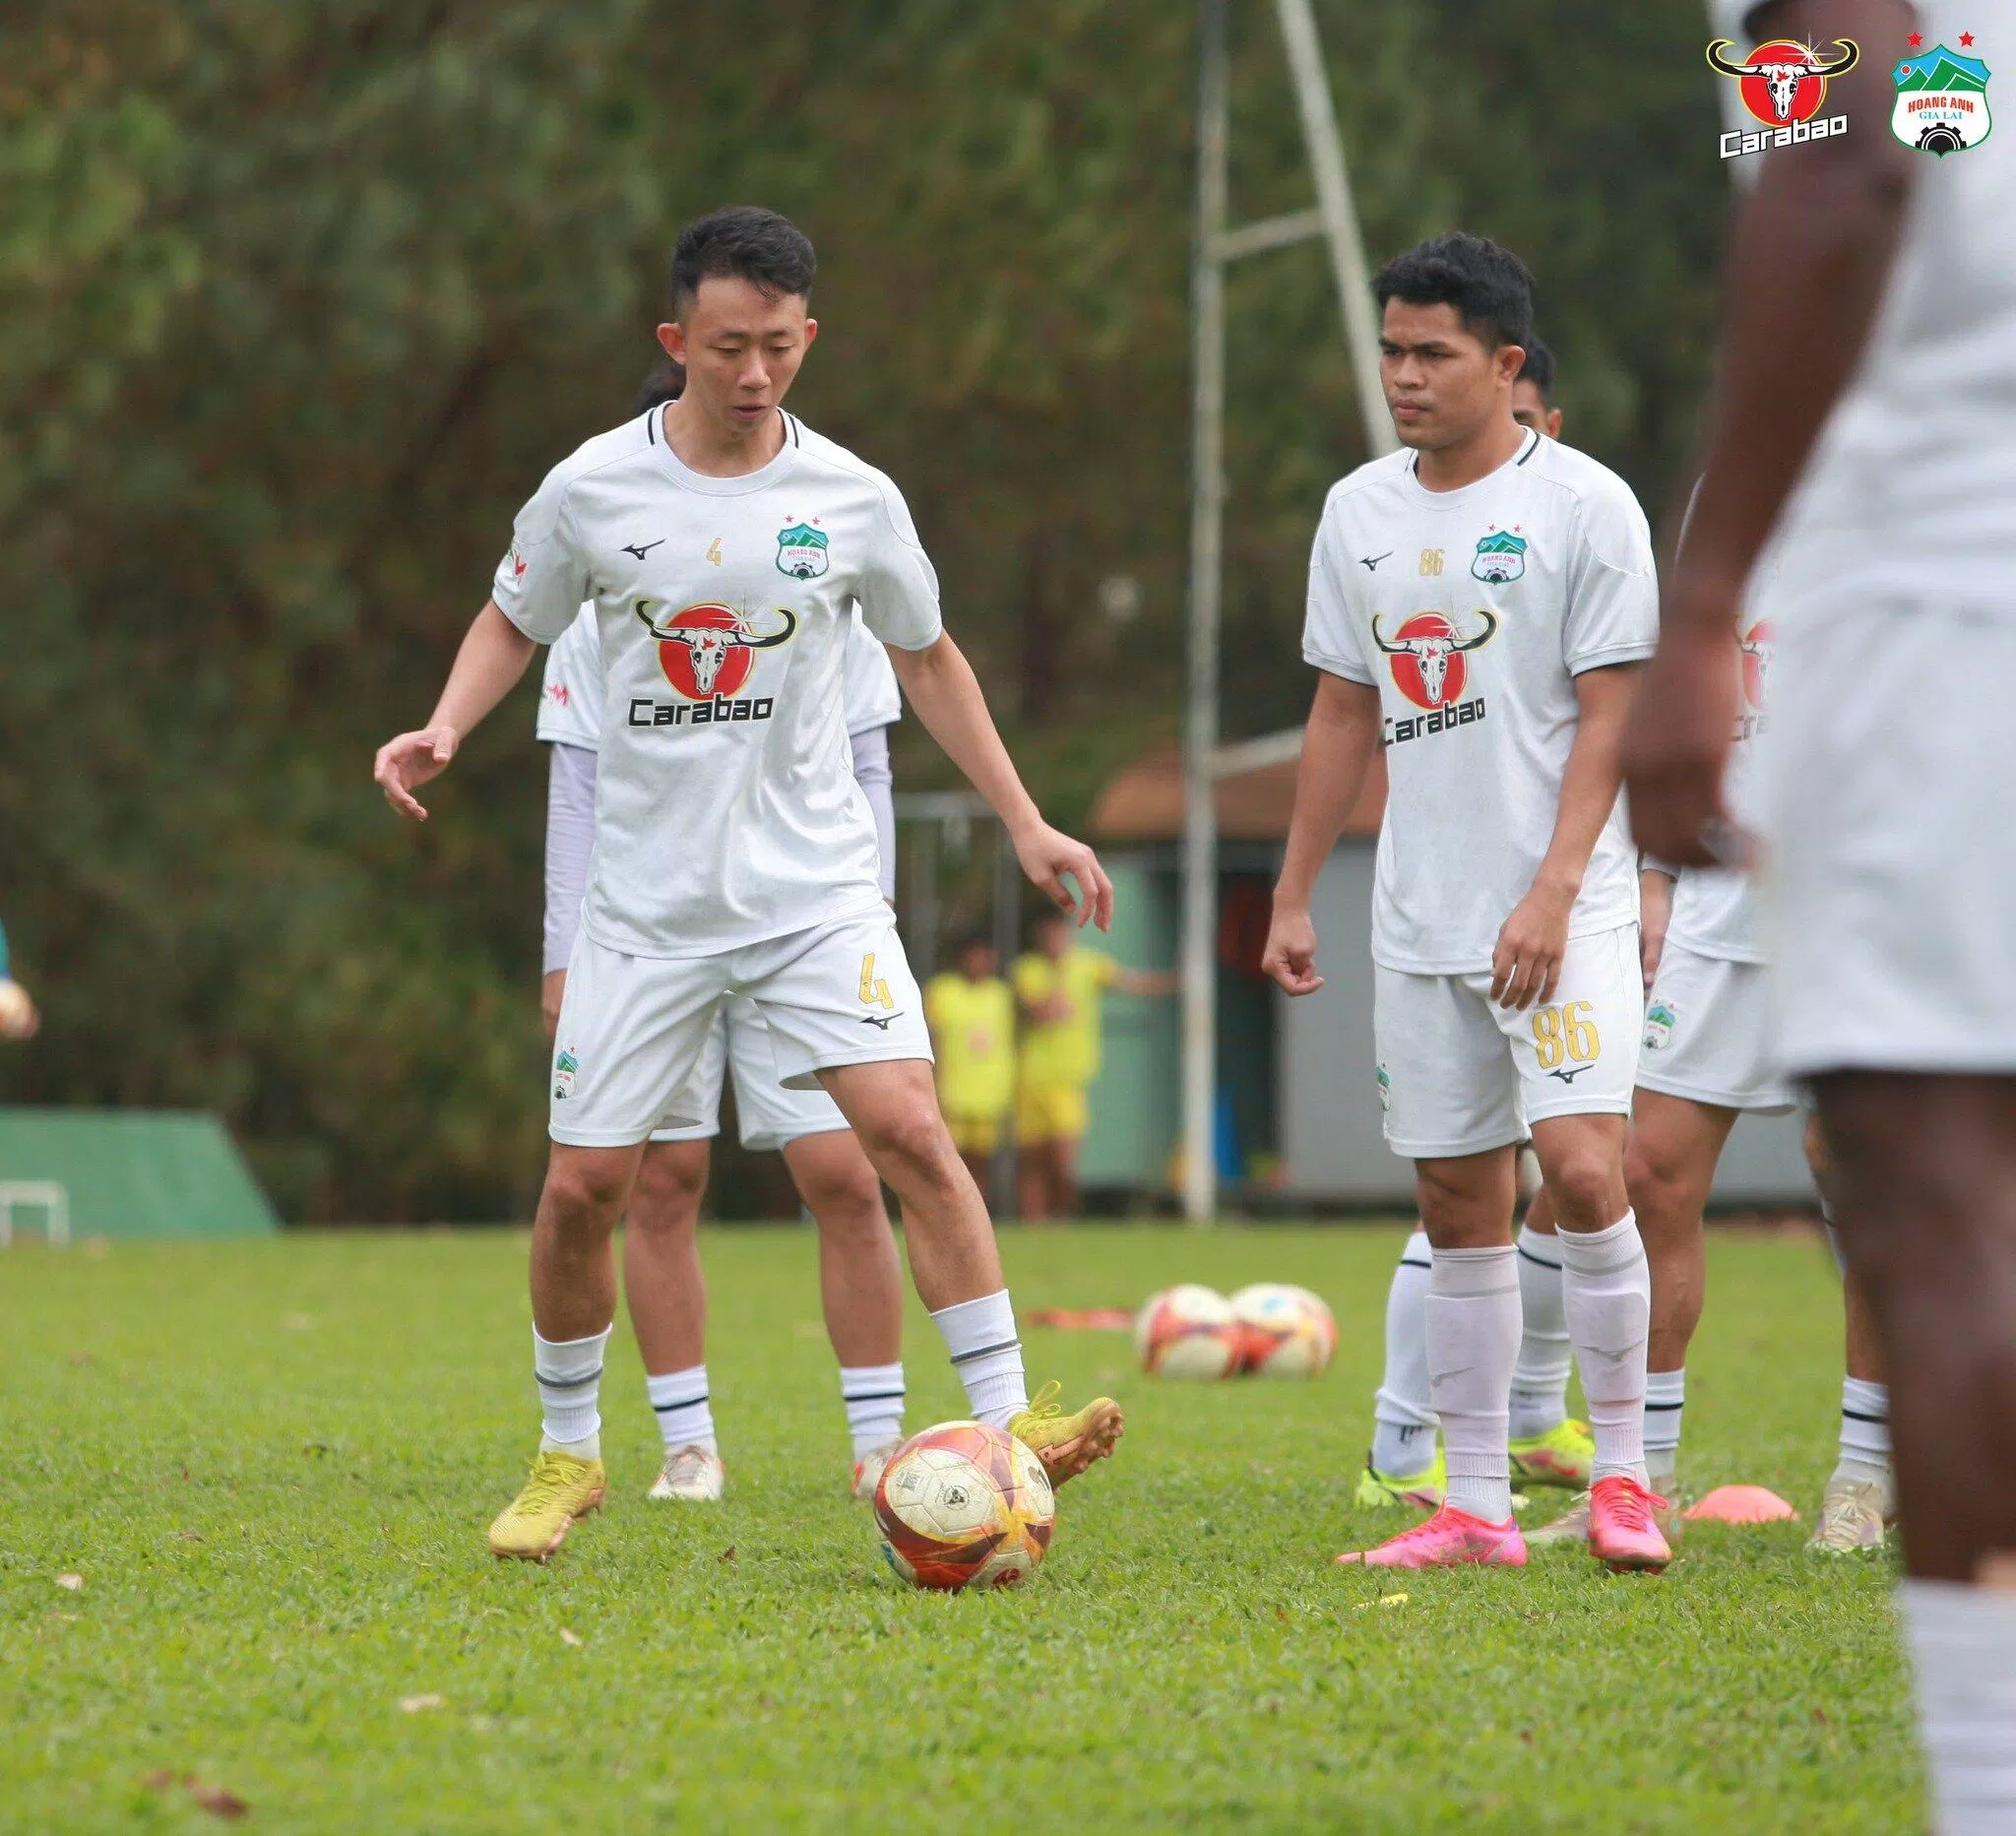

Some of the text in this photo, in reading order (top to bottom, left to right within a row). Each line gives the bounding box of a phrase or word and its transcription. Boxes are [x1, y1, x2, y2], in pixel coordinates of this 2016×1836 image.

[706, 538, 722, 566] 4
[1419, 548, 1445, 576] 86
[628, 693, 774, 727] Carabao
[858, 952, 895, 1010] 4
[1532, 1000, 1601, 1070] 86
